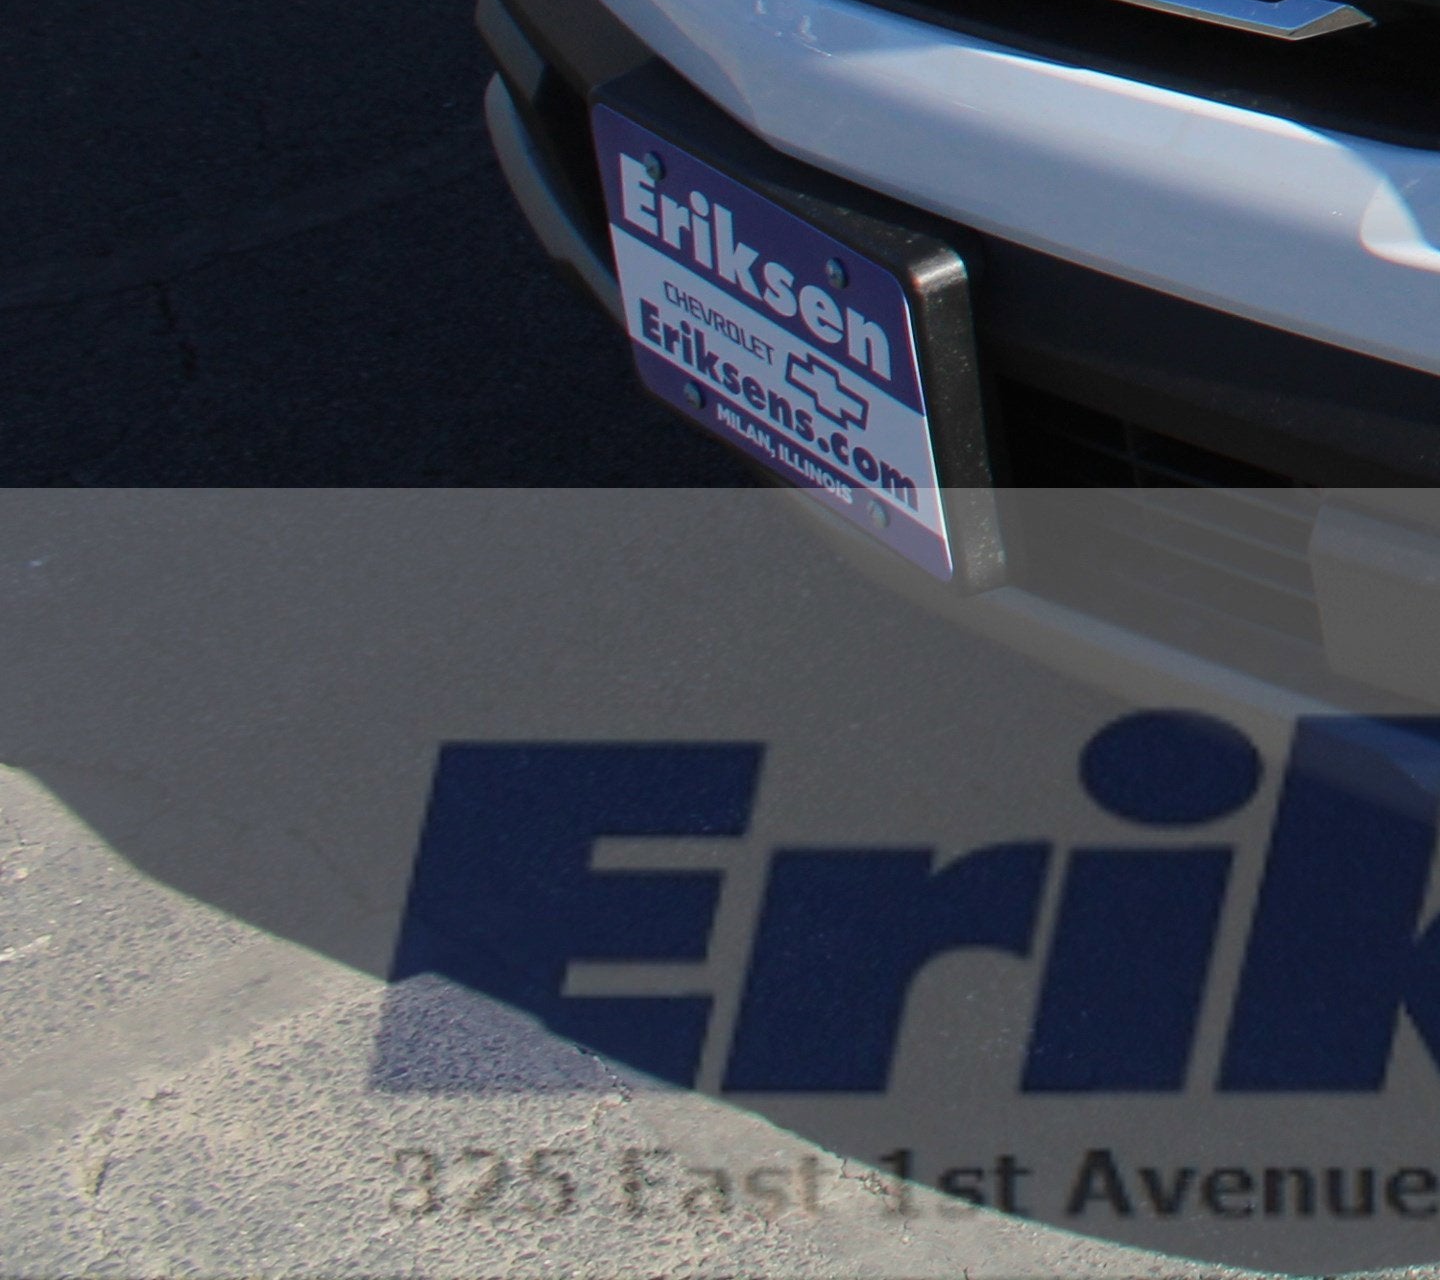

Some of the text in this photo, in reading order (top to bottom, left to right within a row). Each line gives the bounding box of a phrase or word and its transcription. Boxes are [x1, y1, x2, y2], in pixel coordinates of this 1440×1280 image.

[619, 151, 893, 382] Eriksen
[663, 280, 776, 366] CHEVROLET
[638, 297, 920, 513] Eriksens.com
[716, 402, 854, 505] MILAN, ILLINOIS
